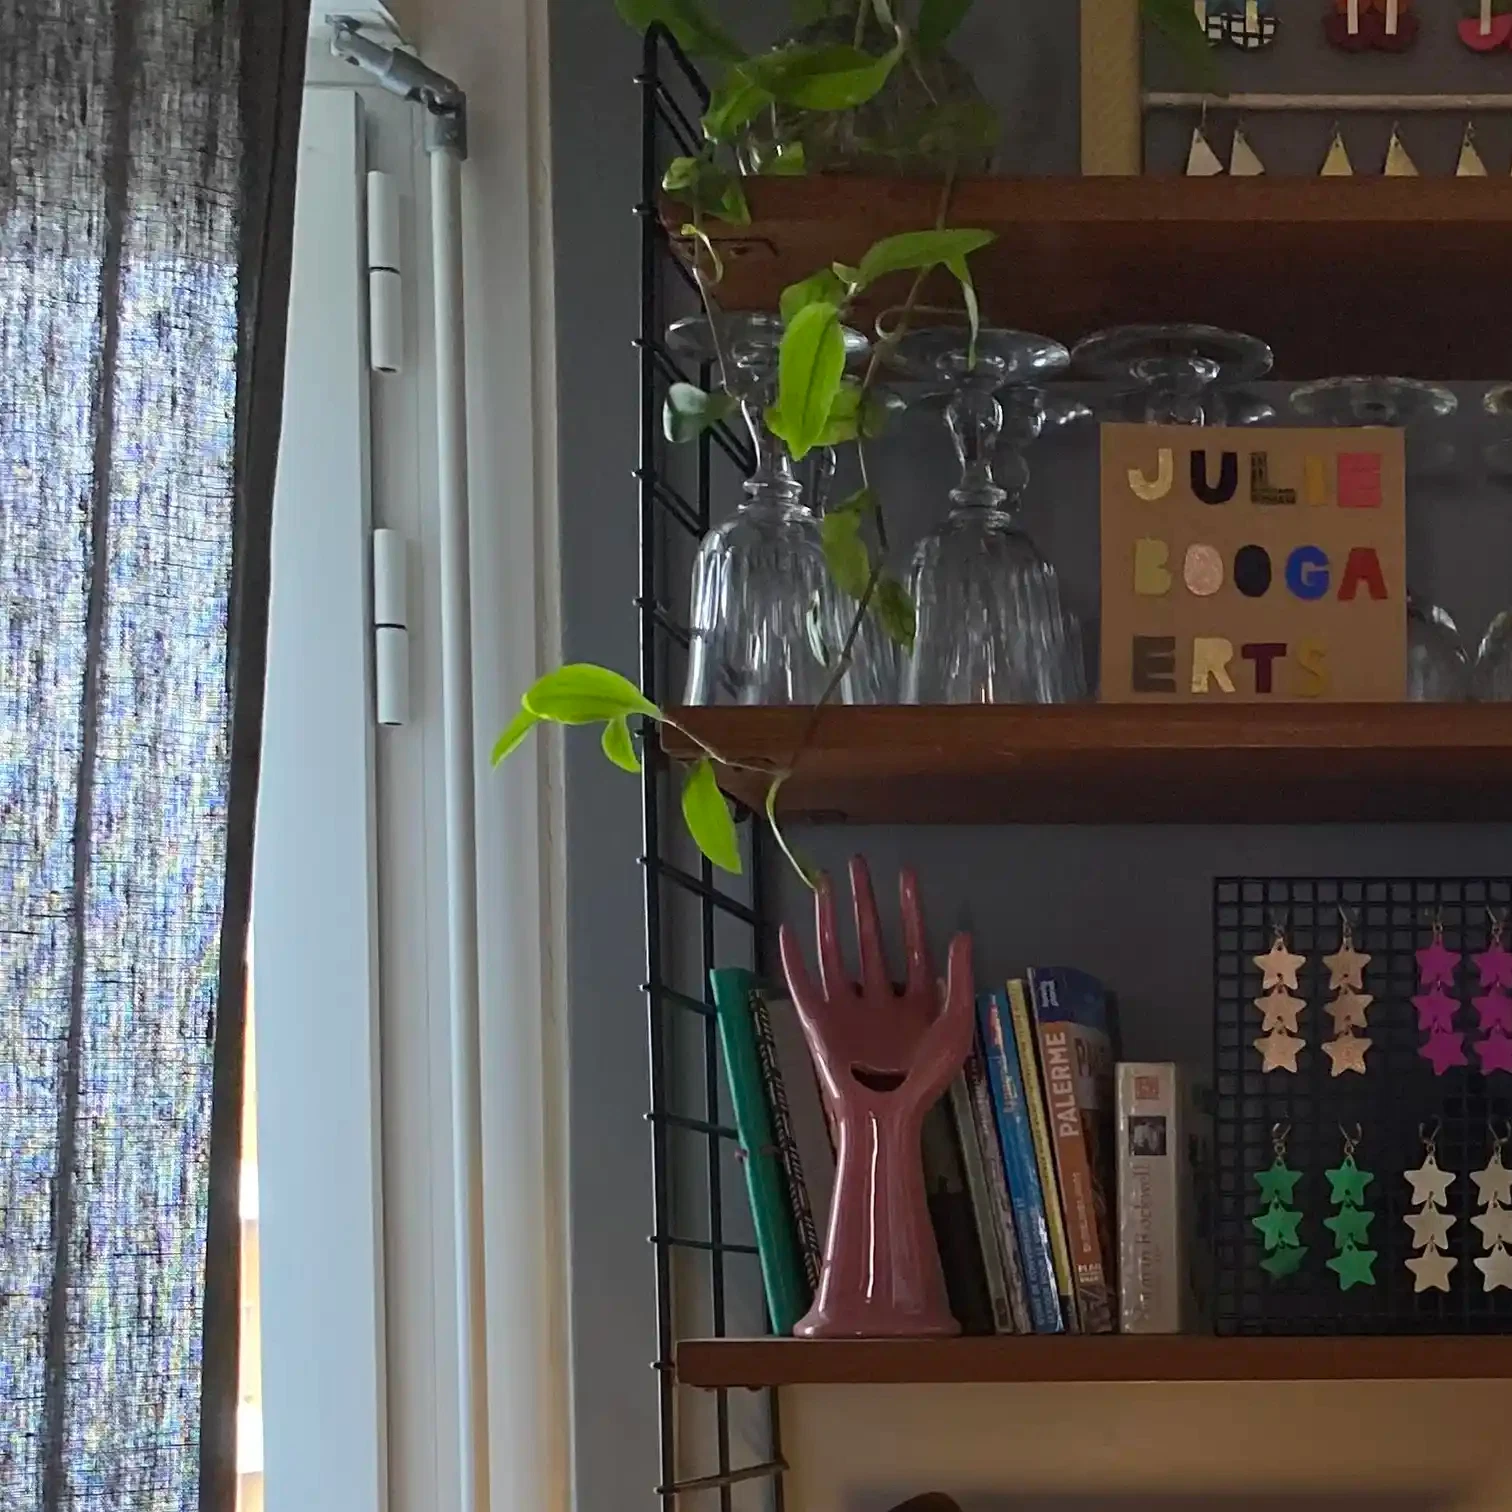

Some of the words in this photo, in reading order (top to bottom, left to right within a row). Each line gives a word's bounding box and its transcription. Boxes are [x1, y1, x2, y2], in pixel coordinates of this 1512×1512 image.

[1127, 447, 1382, 508] JULIE
[1133, 535, 1389, 602] BOOGA
[1132, 635, 1329, 698] ERTS
[1045, 1031, 1080, 1138] PALERME
